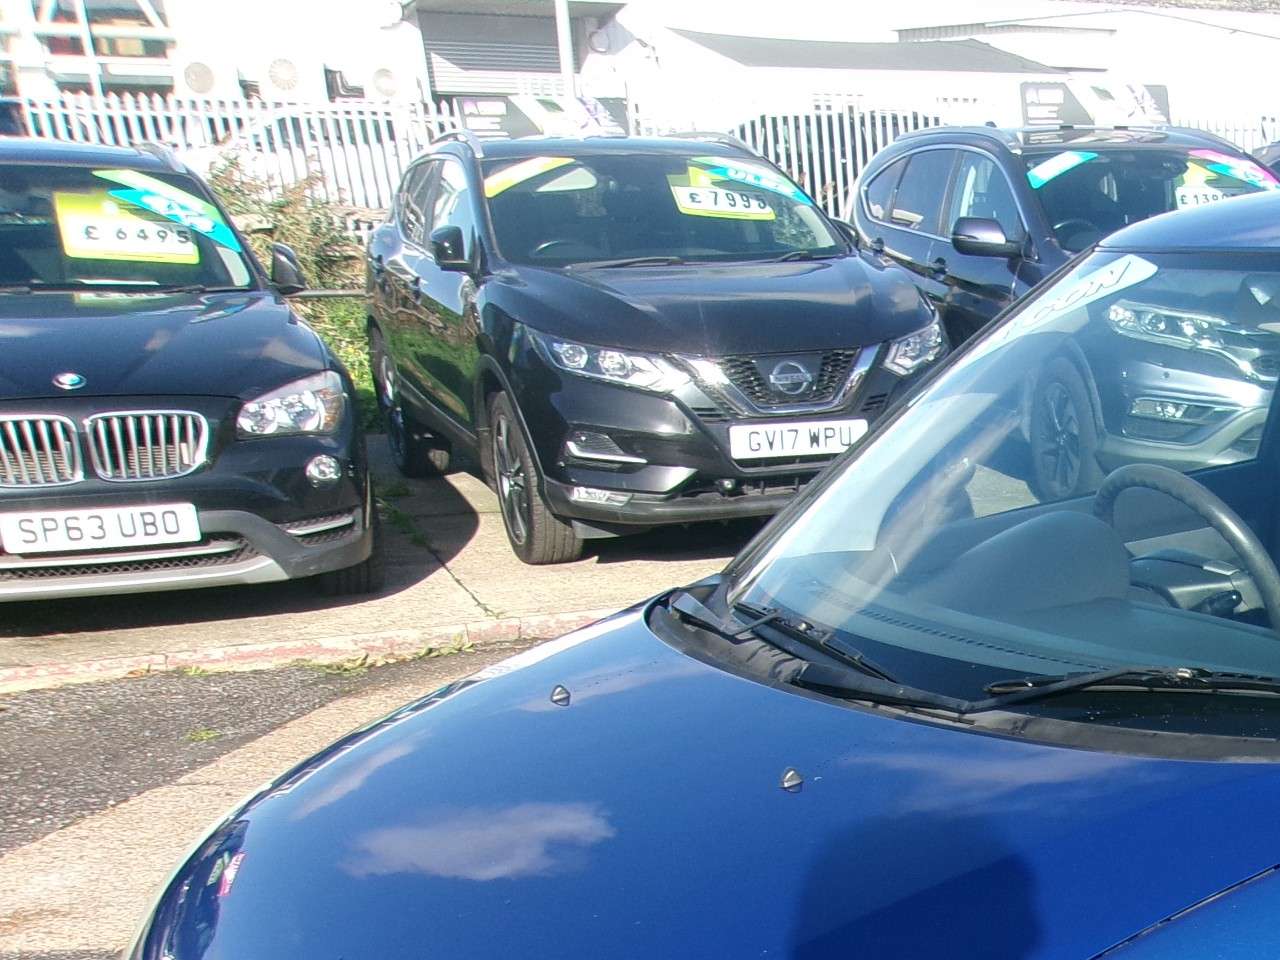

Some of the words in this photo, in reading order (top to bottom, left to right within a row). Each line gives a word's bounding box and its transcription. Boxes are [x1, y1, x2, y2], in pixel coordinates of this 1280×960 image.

[748, 428, 799, 452] GV17
[808, 426, 852, 449] WPU
[17, 514, 107, 545] SP63
[117, 510, 181, 539] UBO
